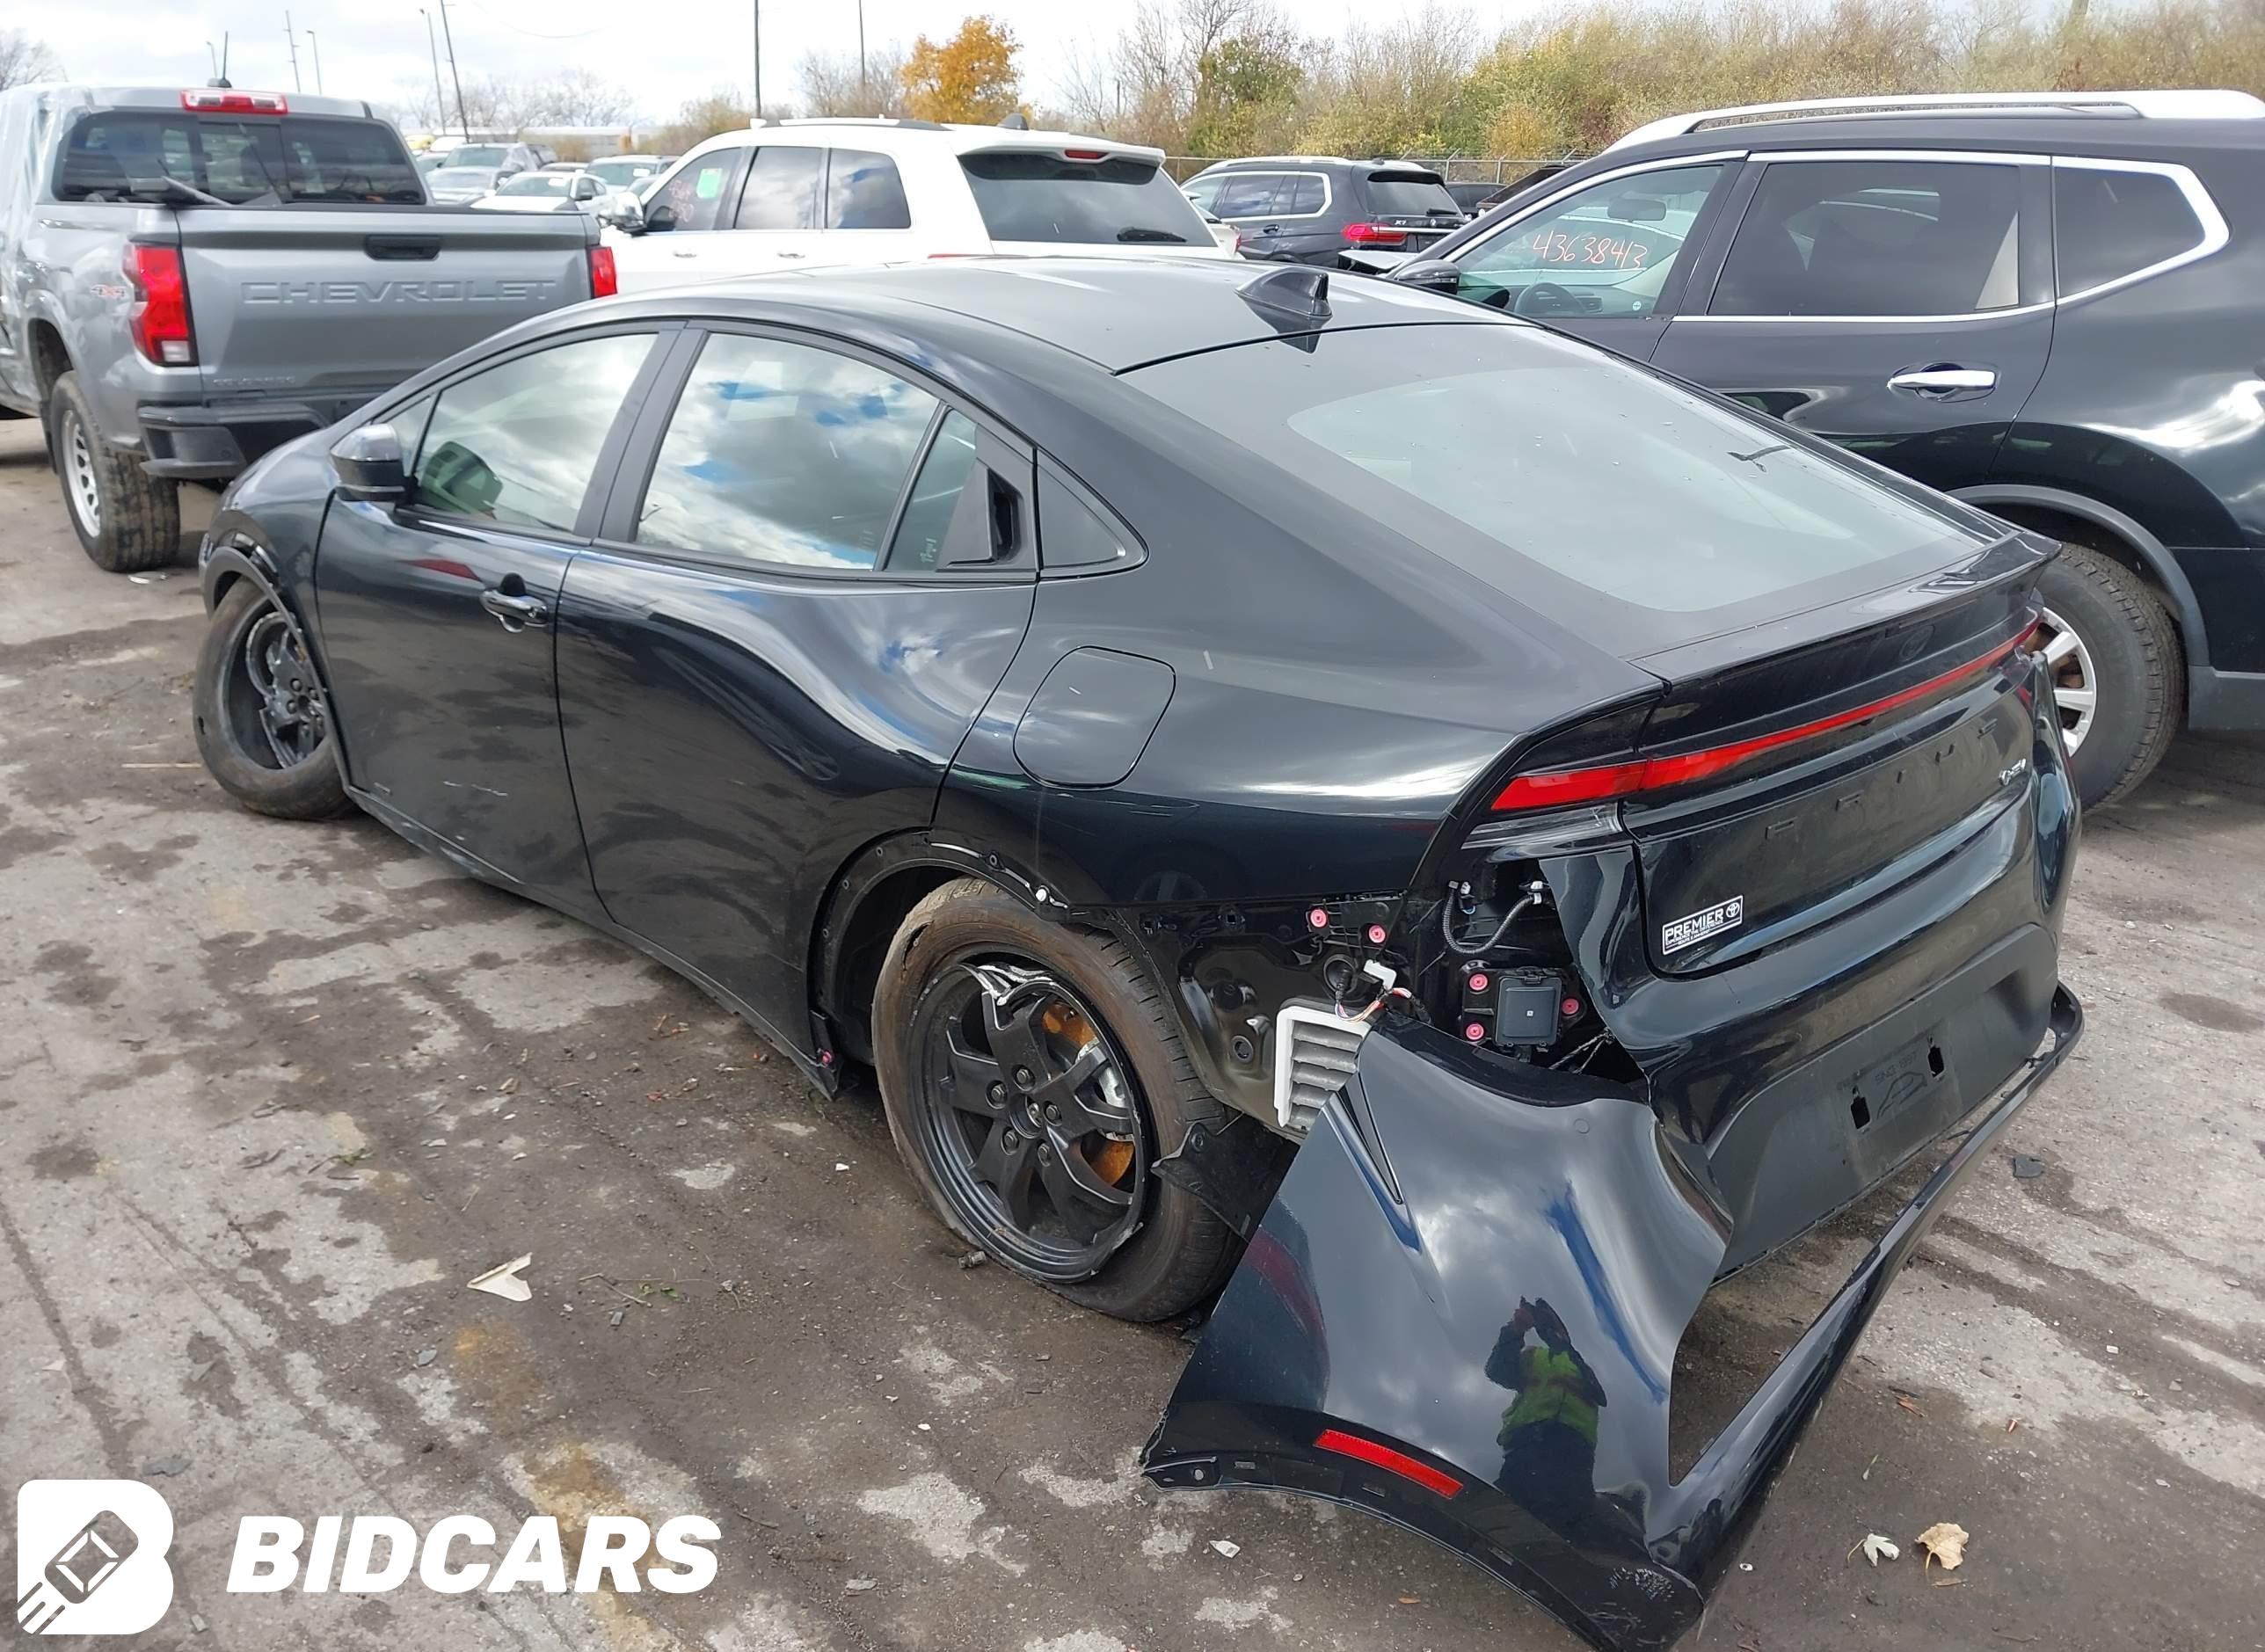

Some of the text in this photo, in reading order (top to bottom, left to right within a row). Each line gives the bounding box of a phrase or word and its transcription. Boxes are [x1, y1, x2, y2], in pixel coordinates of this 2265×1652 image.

[1533, 229, 1648, 269] 43638413
[240, 281, 557, 304] CHEVROLET
[1665, 908, 1724, 942] PREMIER
